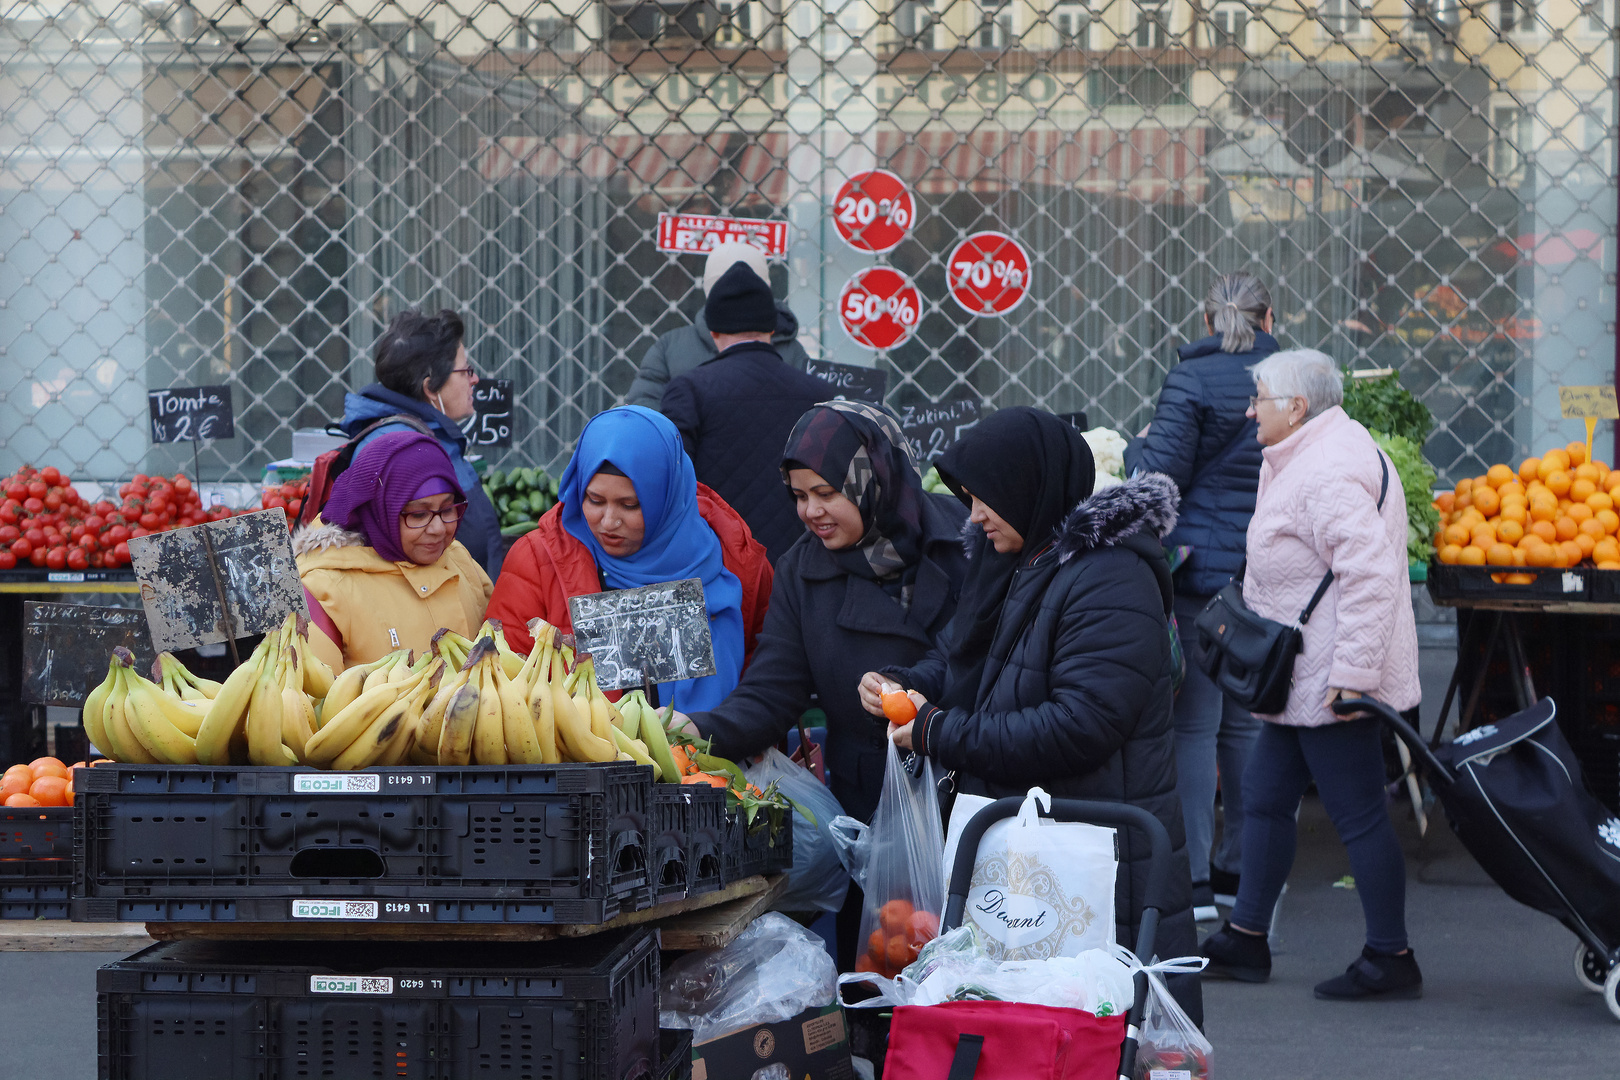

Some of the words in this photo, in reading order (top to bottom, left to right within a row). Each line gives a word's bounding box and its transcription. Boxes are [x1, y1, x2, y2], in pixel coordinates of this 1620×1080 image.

[838, 196, 908, 227] 20%
[677, 218, 725, 231] ALLES
[954, 259, 1022, 289] 70%
[844, 292, 915, 324] 50%
[173, 416, 193, 443] 2
[198, 415, 219, 442] €
[312, 780, 343, 790] IFCO
[388, 775, 413, 785] 6413
[420, 775, 432, 785] LL
[310, 905, 341, 916] IFCO
[385, 903, 411, 912] 6413
[417, 903, 430, 913] LL
[328, 981, 357, 991] IFCO
[400, 979, 424, 989] 6420
[430, 979, 442, 989] LL
